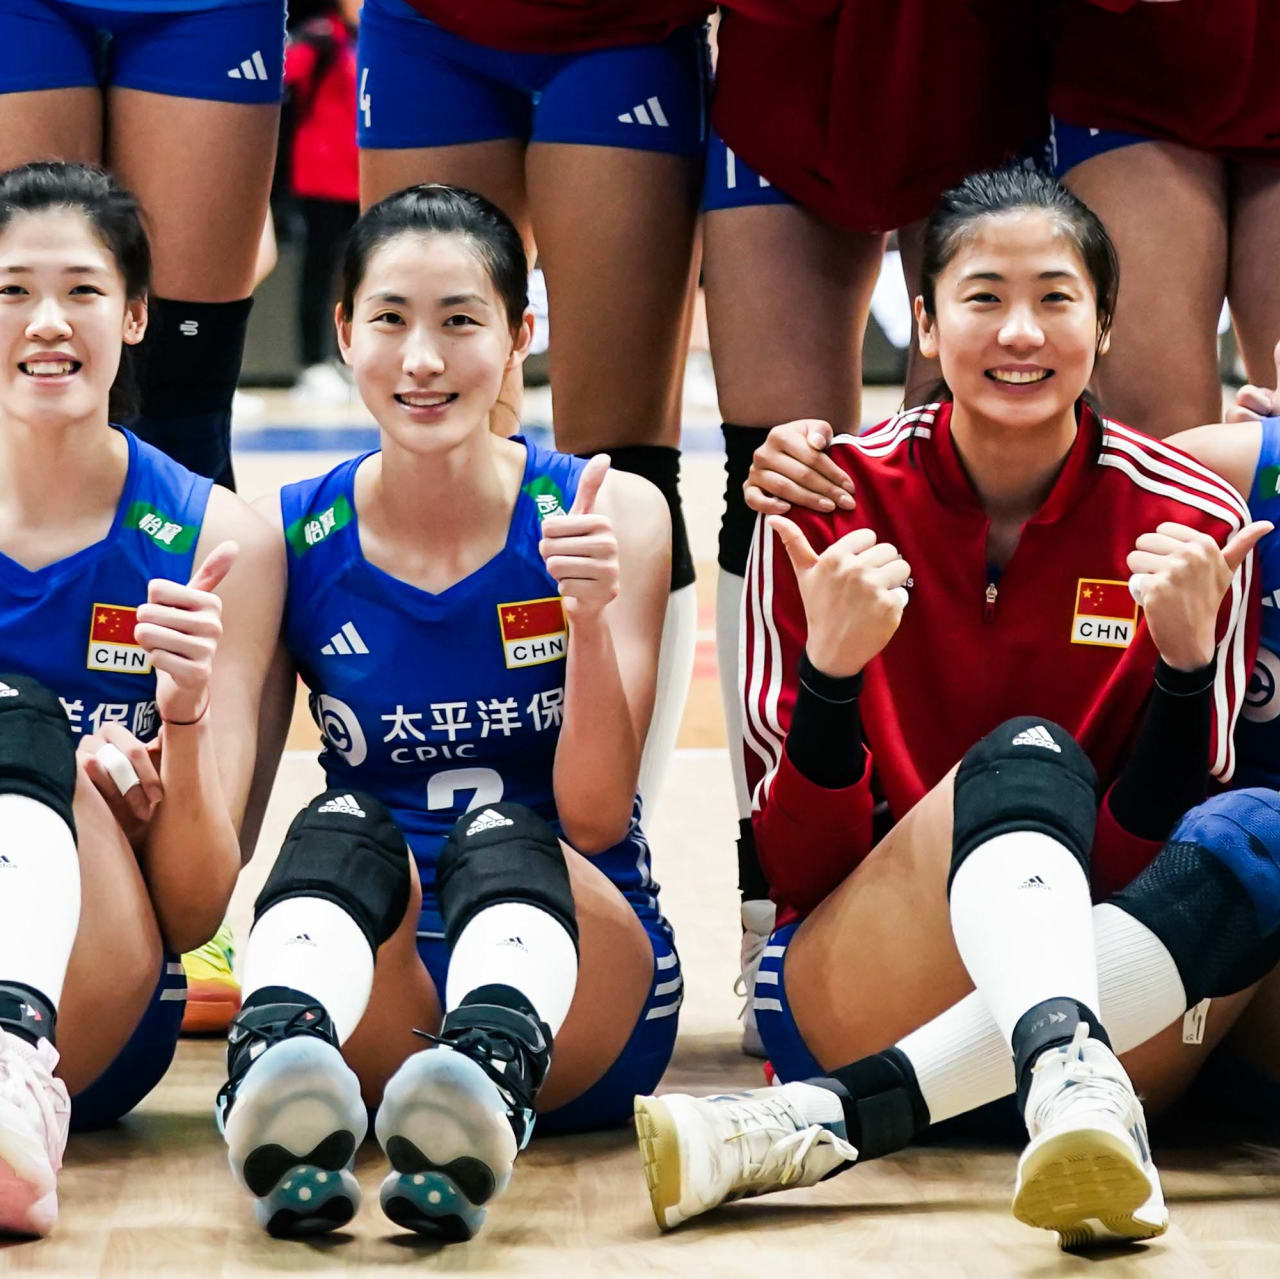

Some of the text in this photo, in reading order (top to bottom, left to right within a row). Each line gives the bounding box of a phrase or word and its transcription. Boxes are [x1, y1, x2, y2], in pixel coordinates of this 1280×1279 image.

[1079, 622, 1128, 641] CHN
[95, 649, 147, 667] CHN
[513, 638, 565, 661] CHN
[1012, 735, 1062, 753] adidas
[390, 742, 480, 765] CPIC
[318, 805, 366, 818] adidas
[466, 818, 514, 836] adidas
